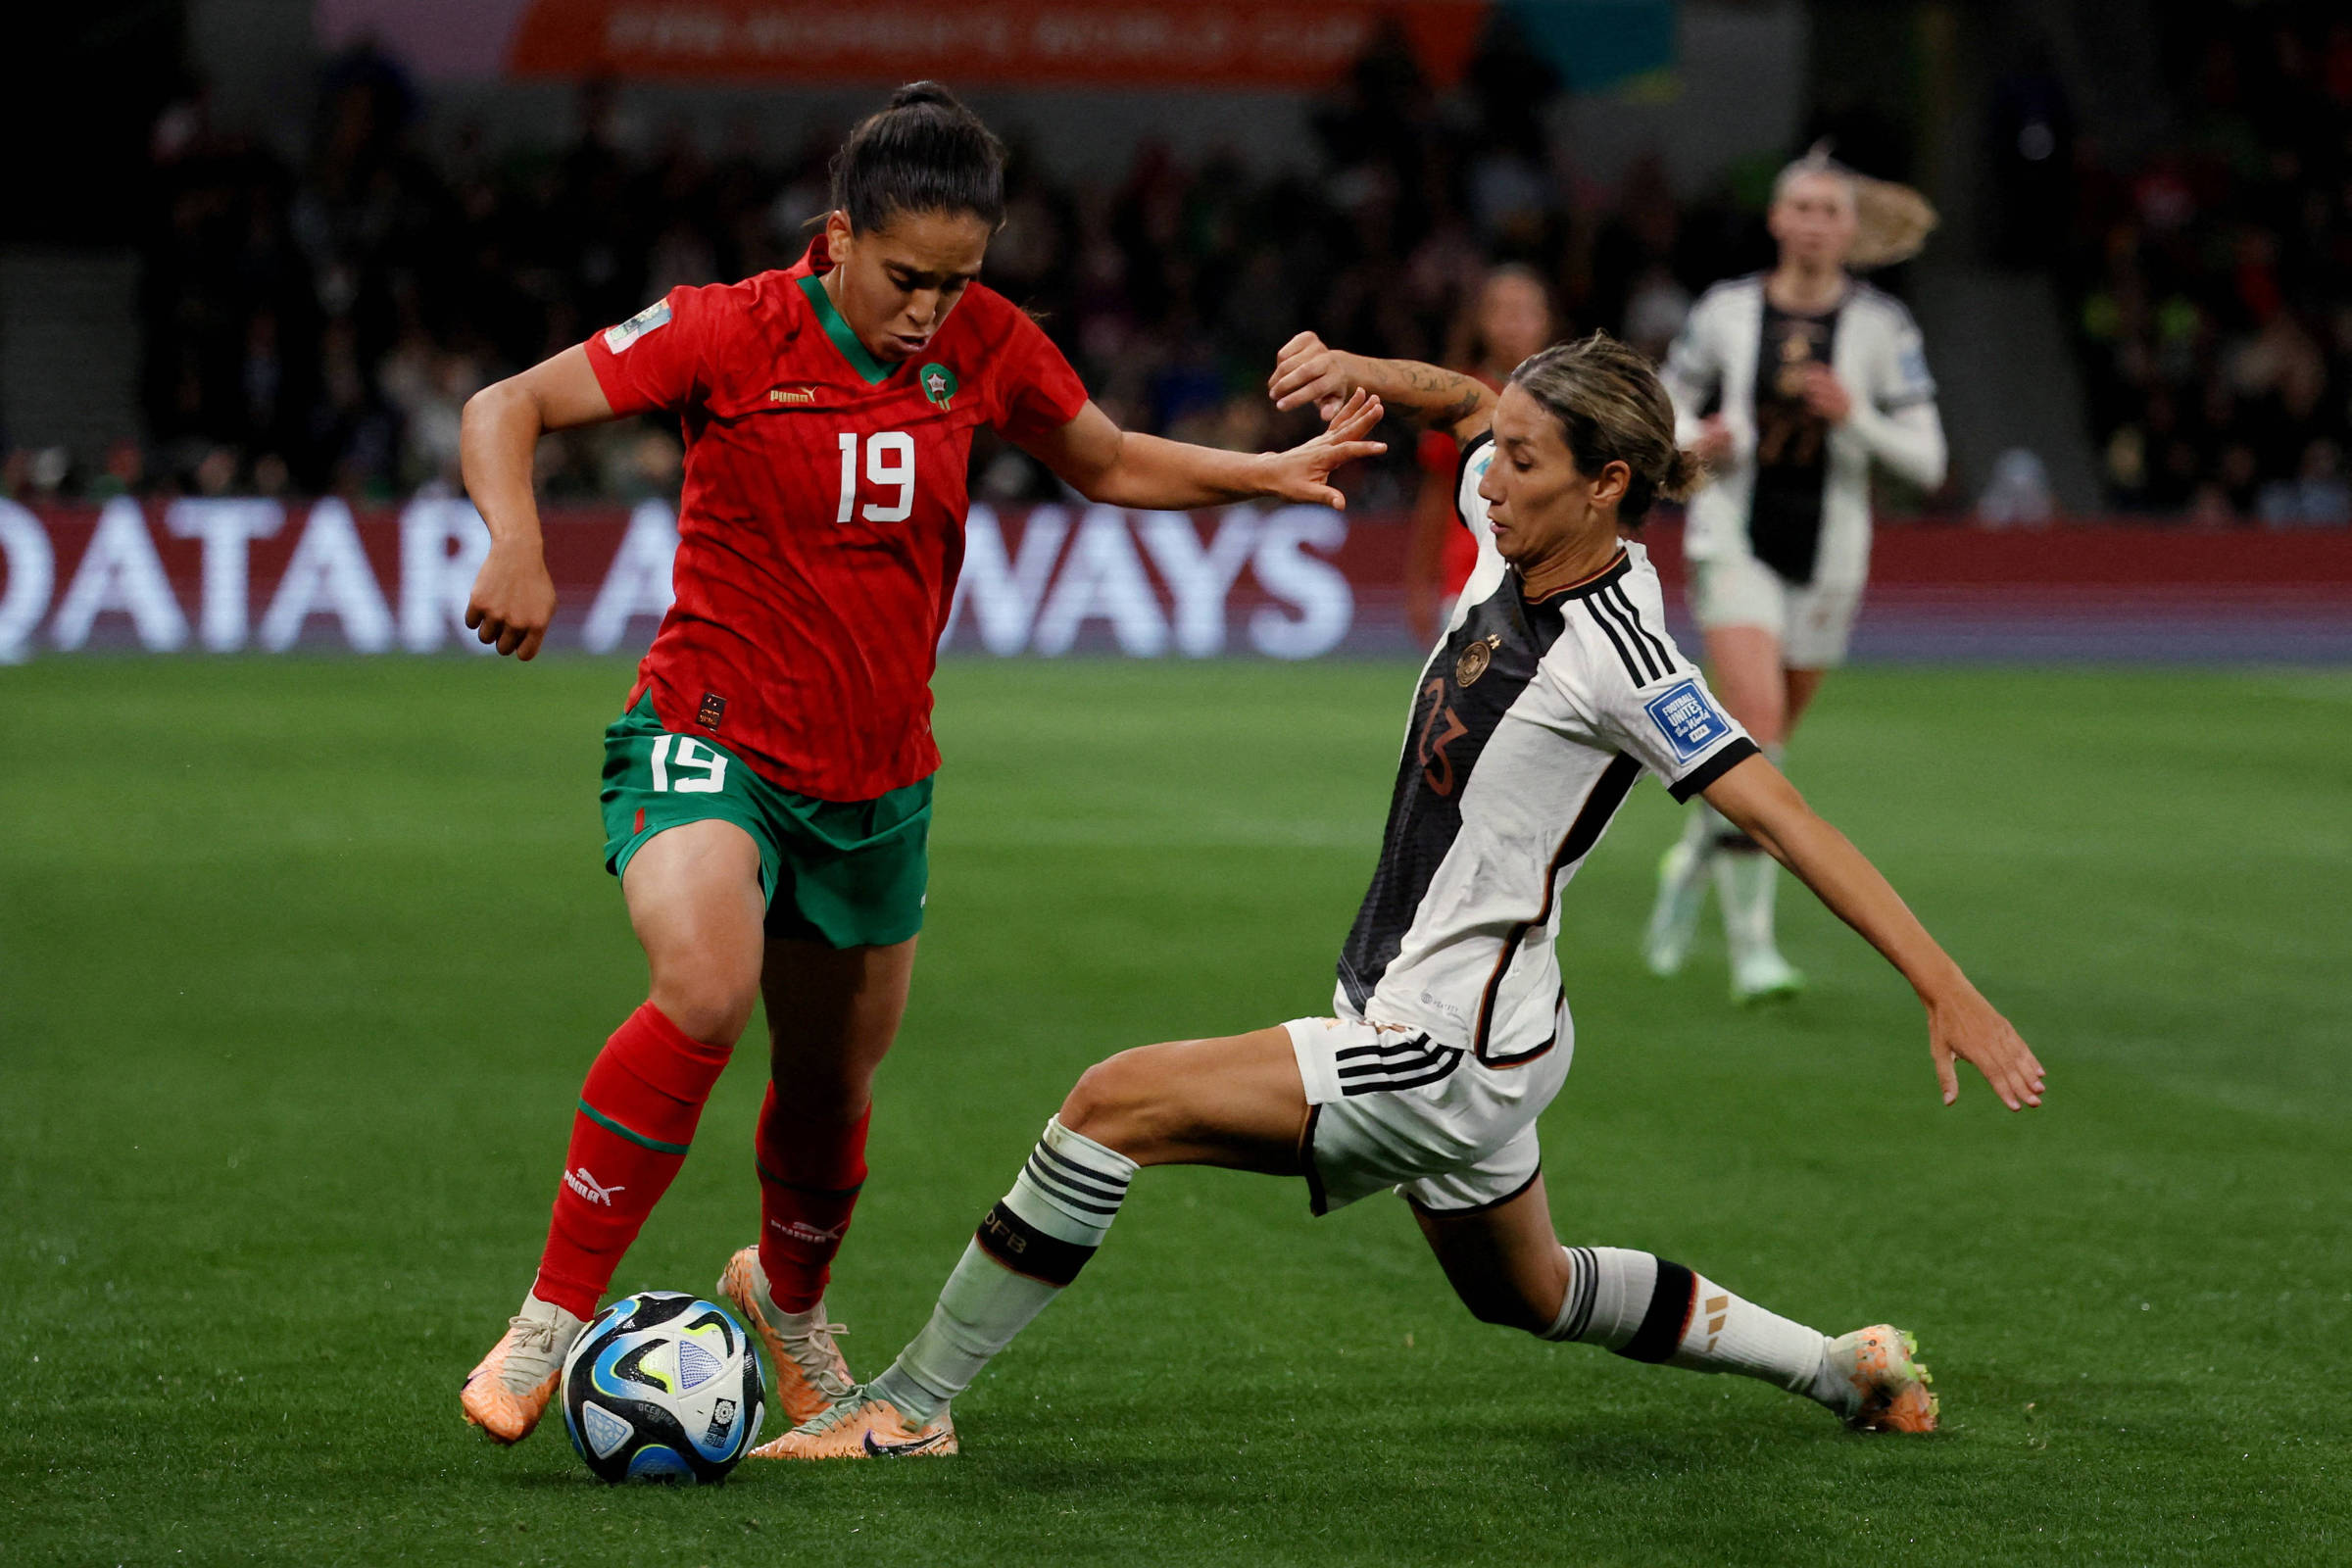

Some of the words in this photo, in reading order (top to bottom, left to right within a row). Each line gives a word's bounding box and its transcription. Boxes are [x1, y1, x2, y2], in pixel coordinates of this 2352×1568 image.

[837, 431, 915, 523] 19
[1662, 692, 1695, 716] FOOTBALL
[1667, 700, 1702, 727] UNITES
[651, 734, 728, 792] 19
[1419, 677, 1468, 796] 23
